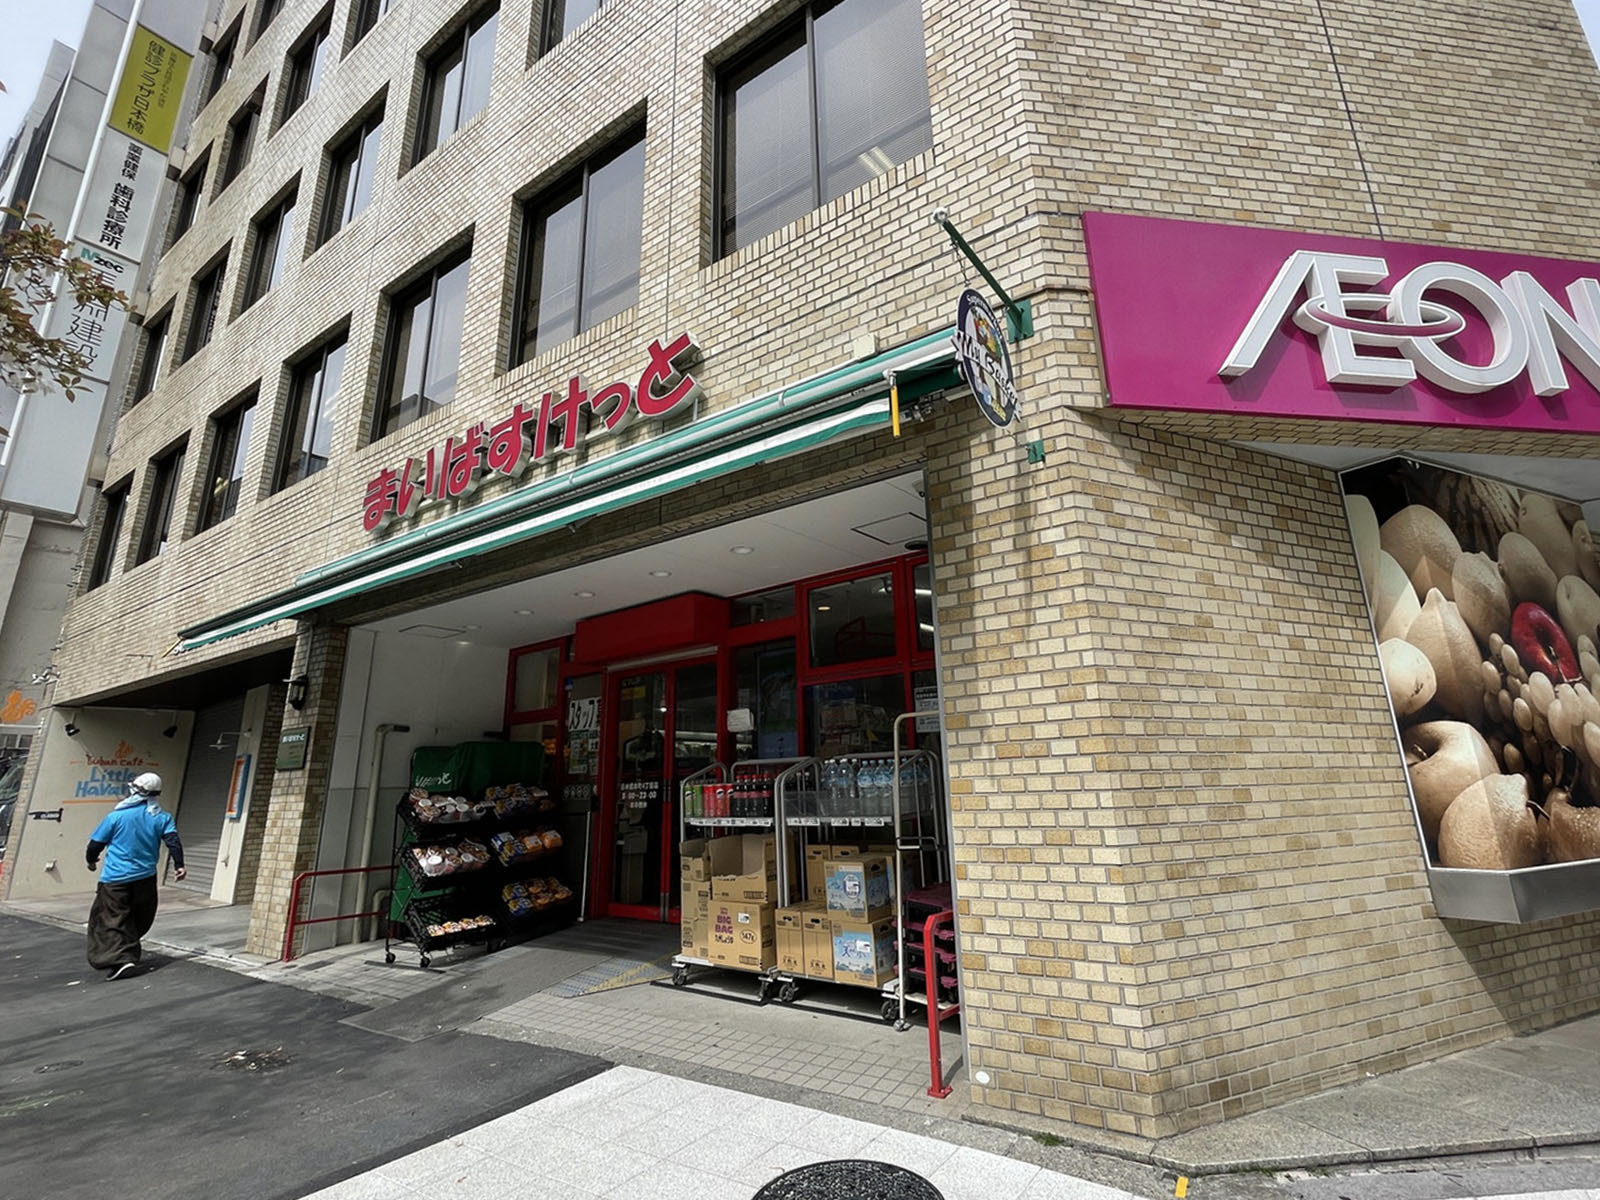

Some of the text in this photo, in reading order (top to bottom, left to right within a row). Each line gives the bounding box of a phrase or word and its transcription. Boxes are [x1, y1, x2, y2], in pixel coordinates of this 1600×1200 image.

[126, 39, 165, 136] 健診プラザ日本橋
[99, 182, 135, 250] 歯科診療所
[362, 330, 702, 532] まいばすけっと
[89, 766, 137, 783] Little
[715, 924, 734, 934] BAG
[717, 914, 732, 924] BIG
